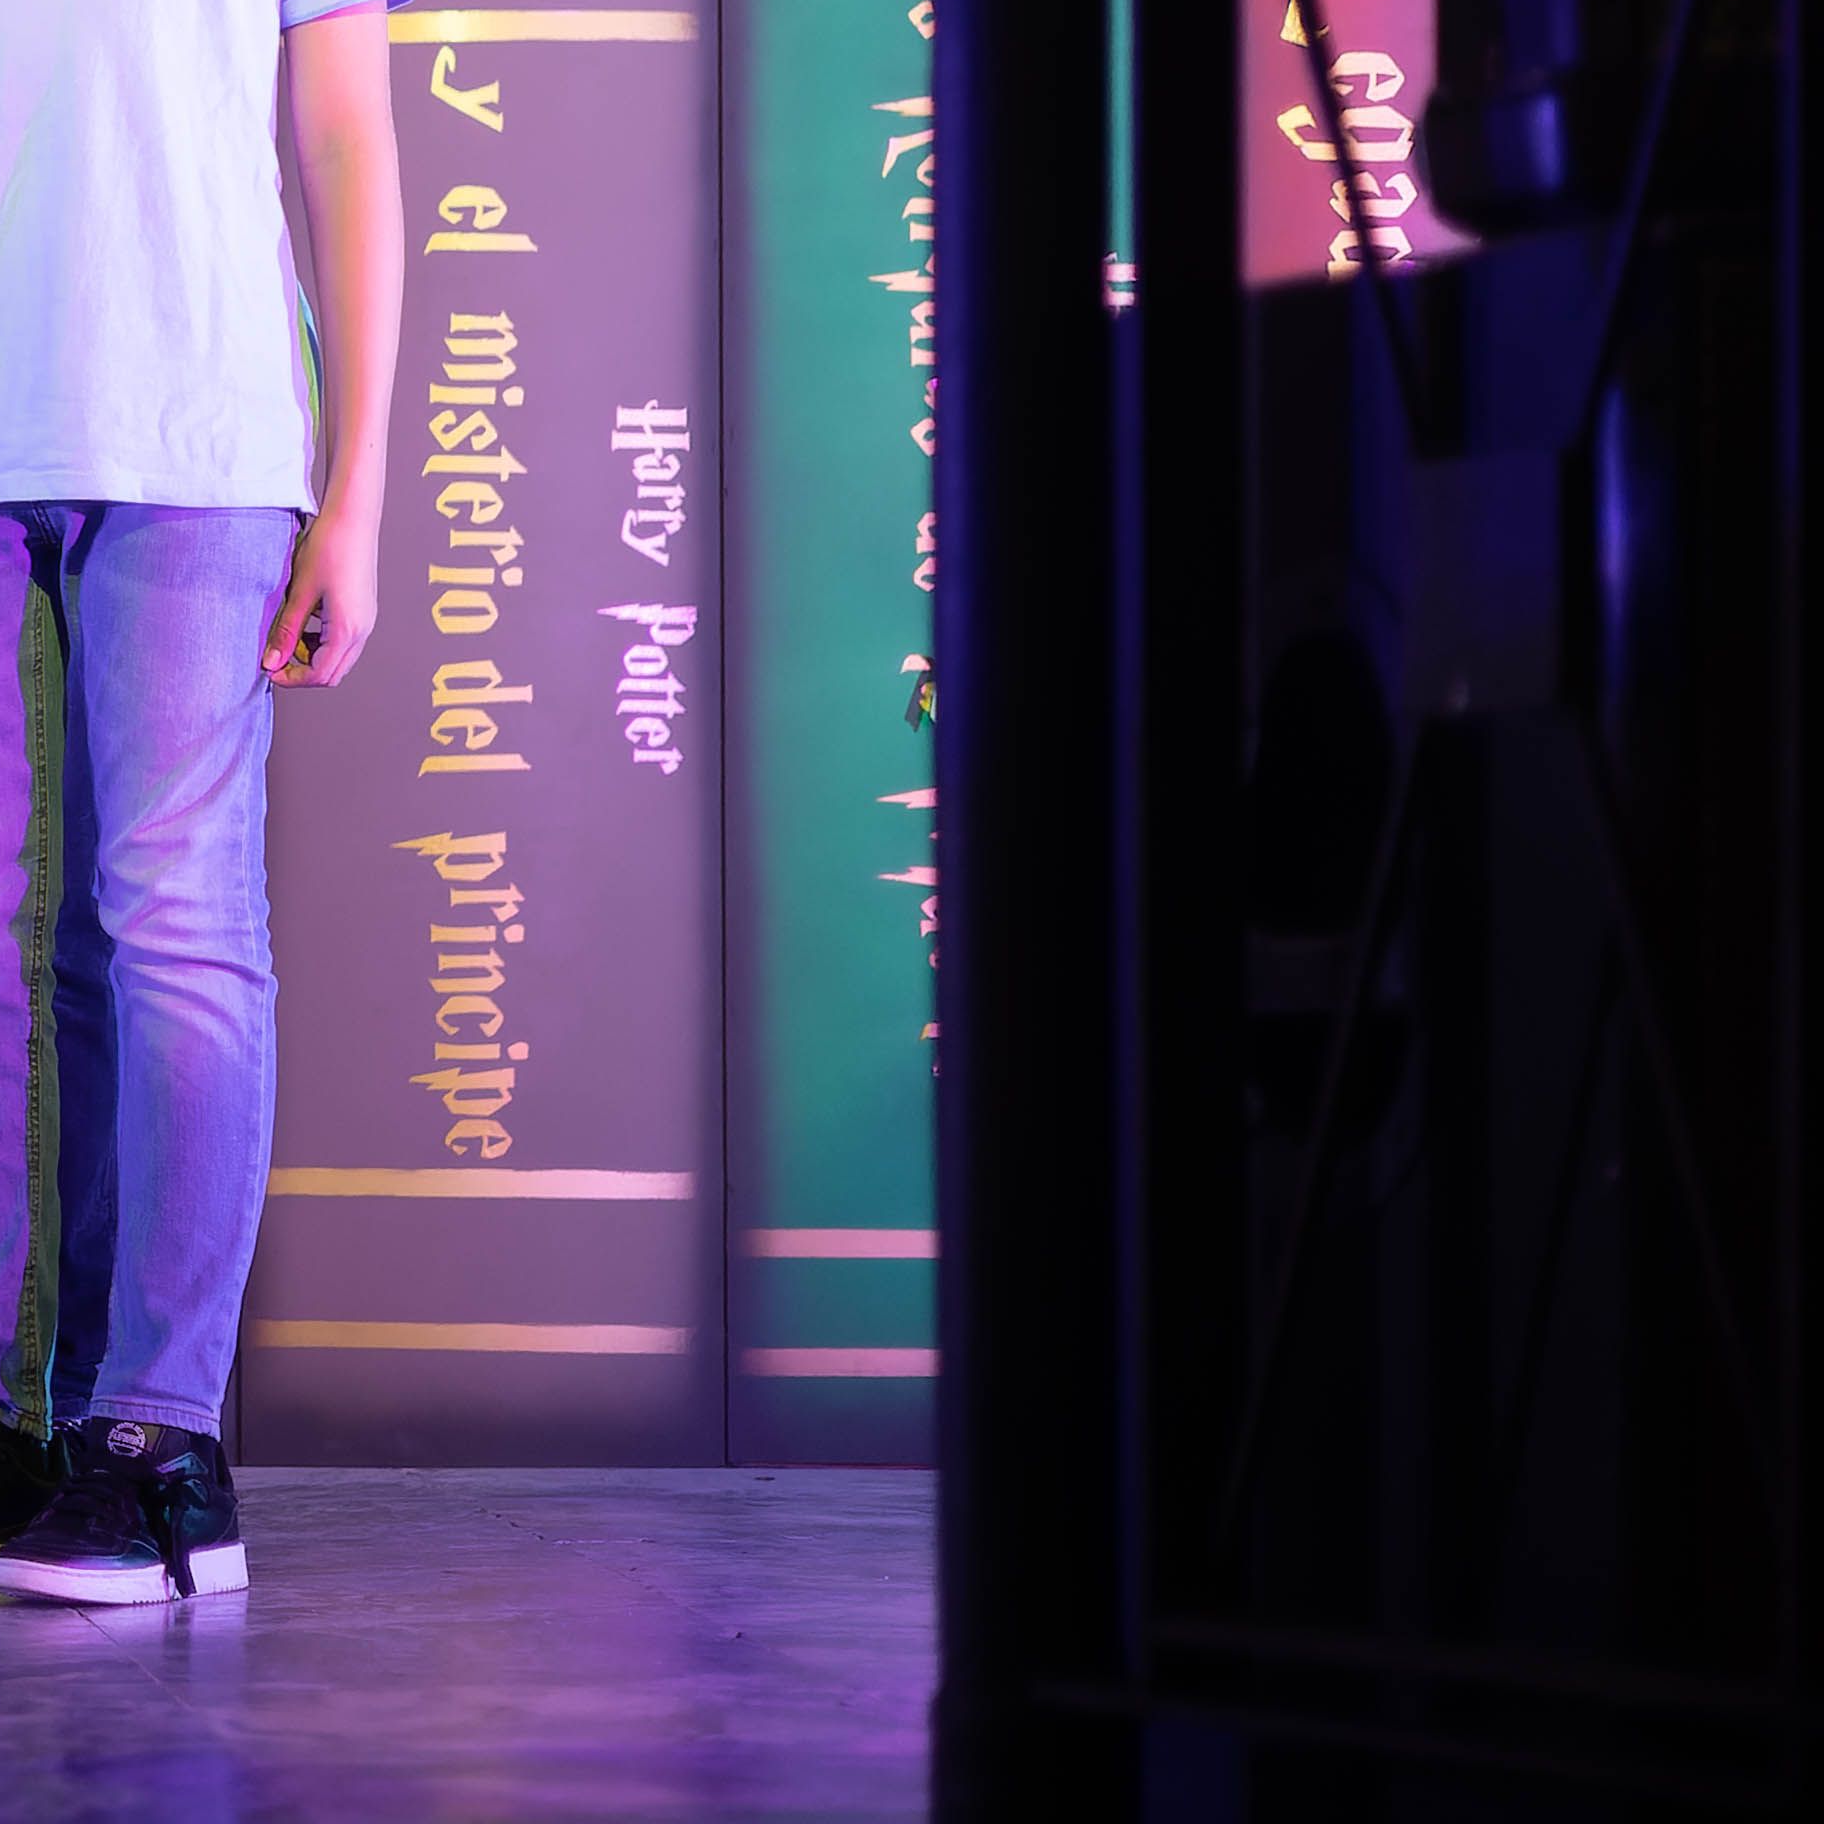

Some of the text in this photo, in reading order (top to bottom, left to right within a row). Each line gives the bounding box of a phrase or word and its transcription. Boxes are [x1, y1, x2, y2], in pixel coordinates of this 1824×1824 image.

[389, 45, 538, 1160] y el misterio del principe
[596, 399, 698, 776] Harry Potter
